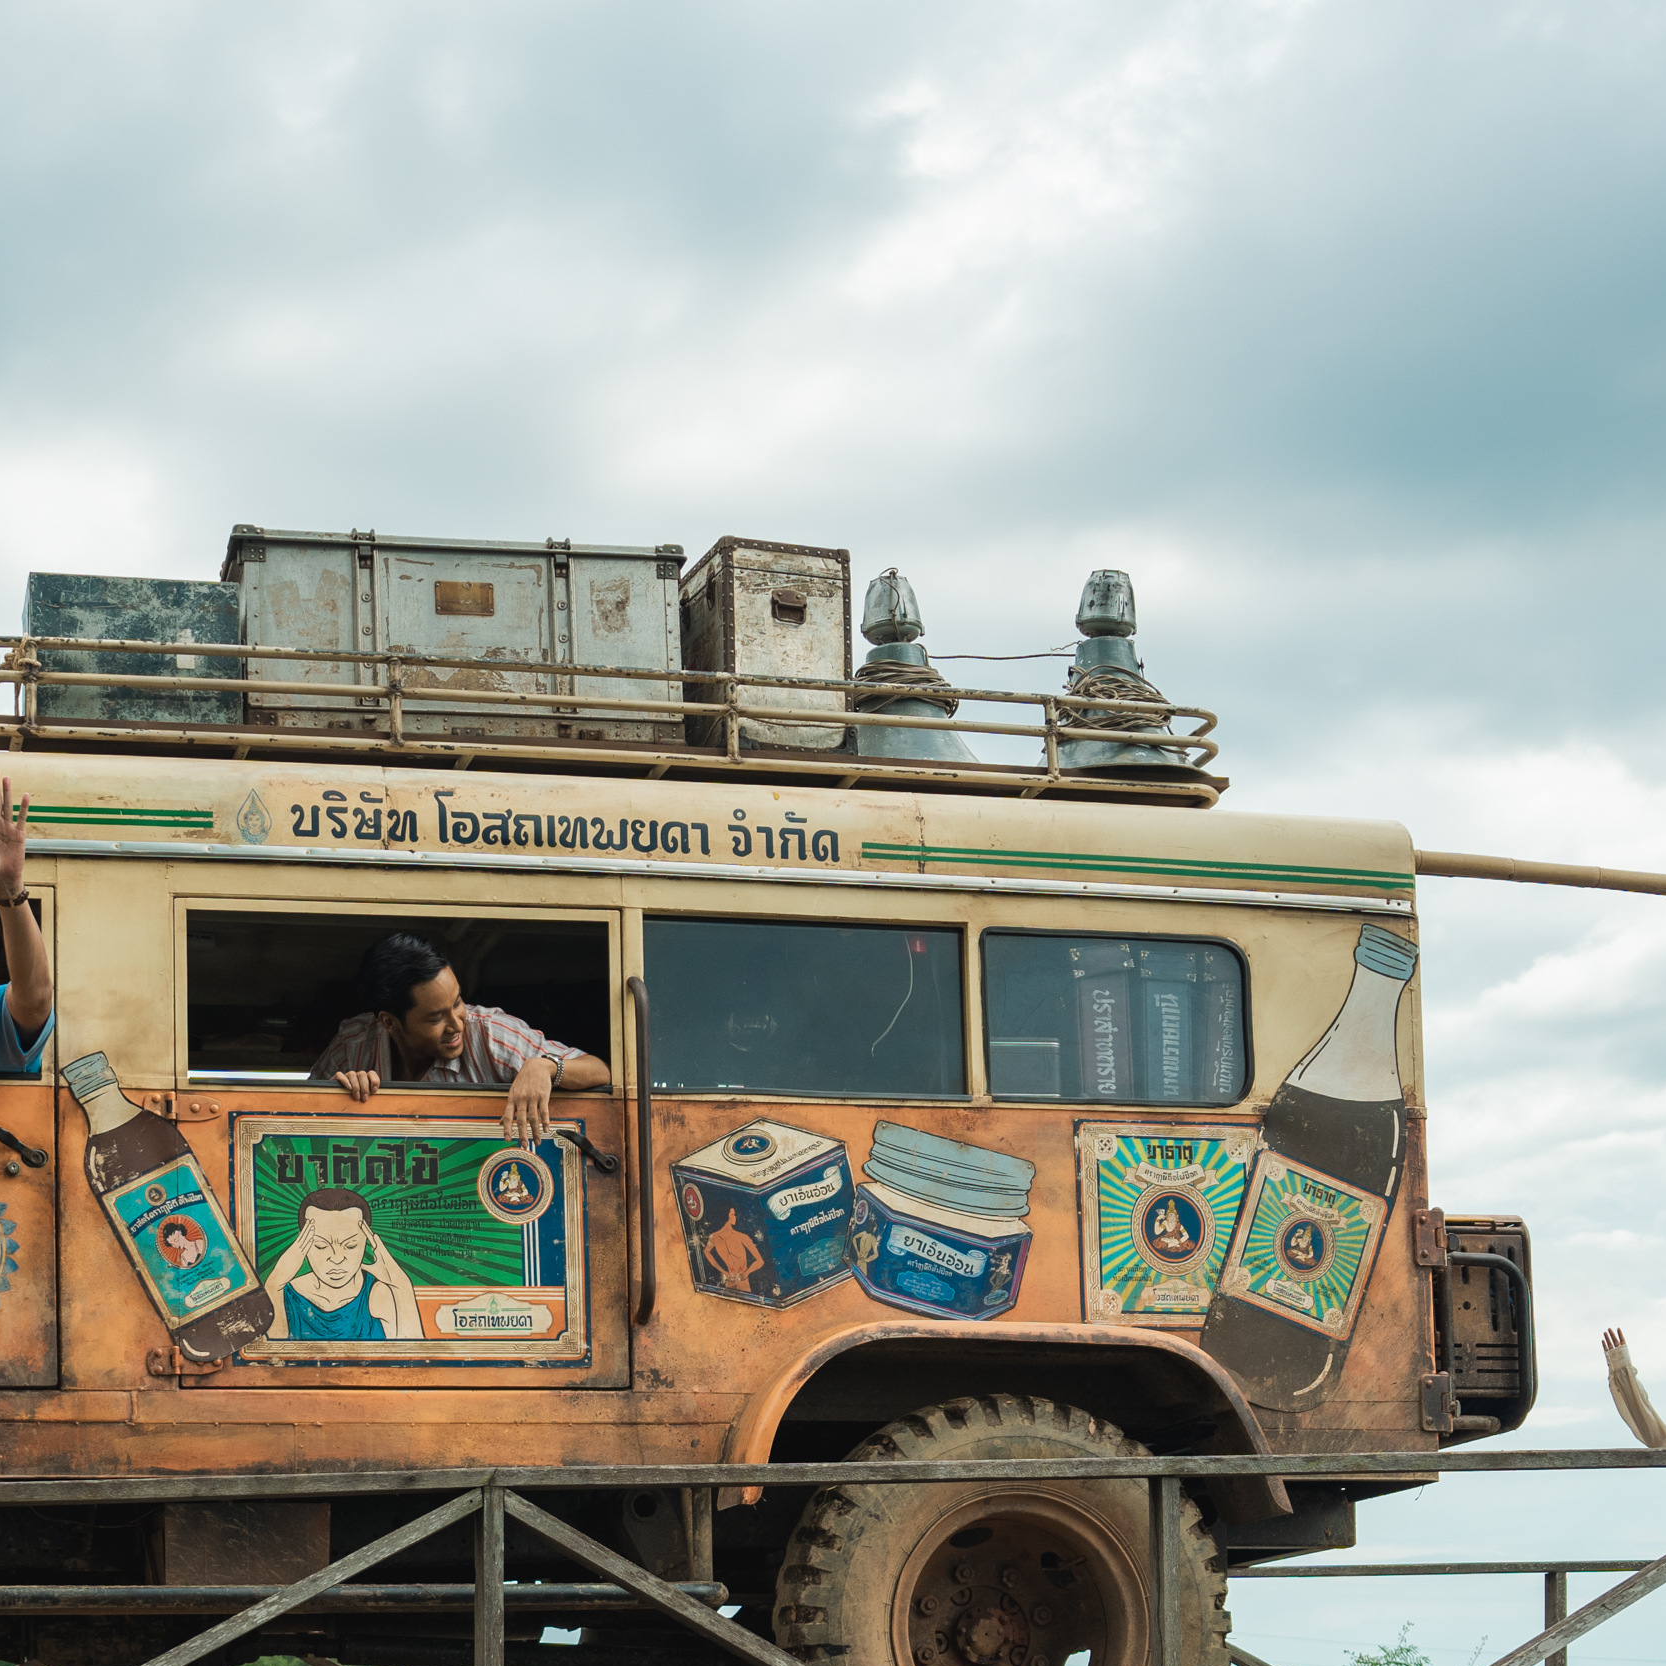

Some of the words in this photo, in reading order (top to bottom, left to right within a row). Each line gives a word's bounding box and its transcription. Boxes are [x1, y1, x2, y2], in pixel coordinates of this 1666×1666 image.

[290, 789, 419, 842] บริษัท
[435, 790, 711, 857] โอสถเทพยดา
[727, 808, 840, 863] จำกัด
[277, 1142, 439, 1185] ยาตัดไข้
[1146, 1144, 1194, 1165] ยาธาตุ
[779, 1184, 835, 1208] ยาเอ็นอ่อน
[1303, 1182, 1337, 1209] ยาธาตุ
[903, 1234, 975, 1276] ยาเอ็นอ่อน
[452, 1308, 533, 1328] โอสถเทพยดา
